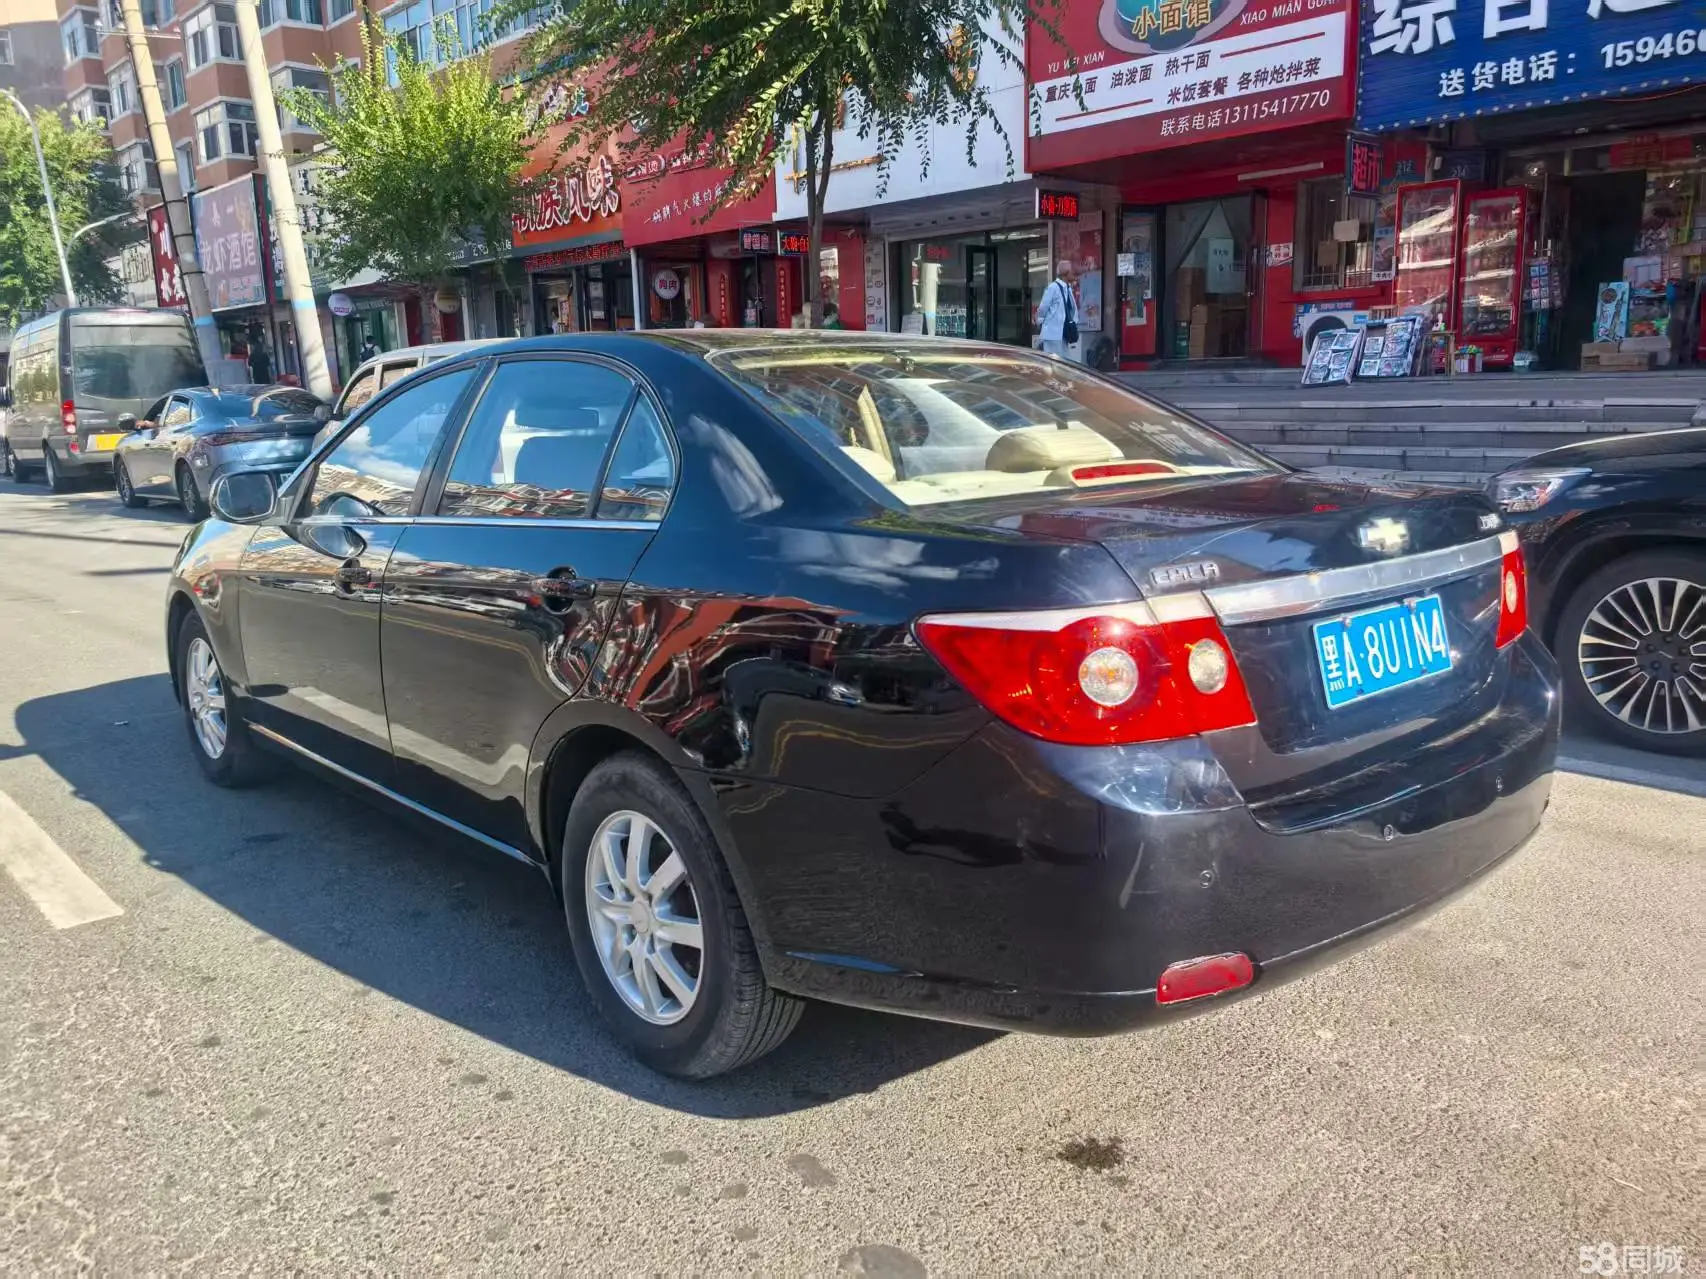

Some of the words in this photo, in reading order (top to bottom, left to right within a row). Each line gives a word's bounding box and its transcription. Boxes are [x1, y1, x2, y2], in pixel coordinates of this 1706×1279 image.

[1131, 0, 1212, 40] 小面馆
[1239, 9, 1267, 26] XIAO
[1048, 63, 1059, 74] YU
[1083, 50, 1105, 65] XIAN
[1110, 63, 1153, 89] 油泼面
[1164, 50, 1212, 77] 热干面
[1167, 76, 1228, 105] 米饭套餐
[1237, 56, 1322, 92] 各种炝拌菜
[1353, 143, 1380, 190] 超市
